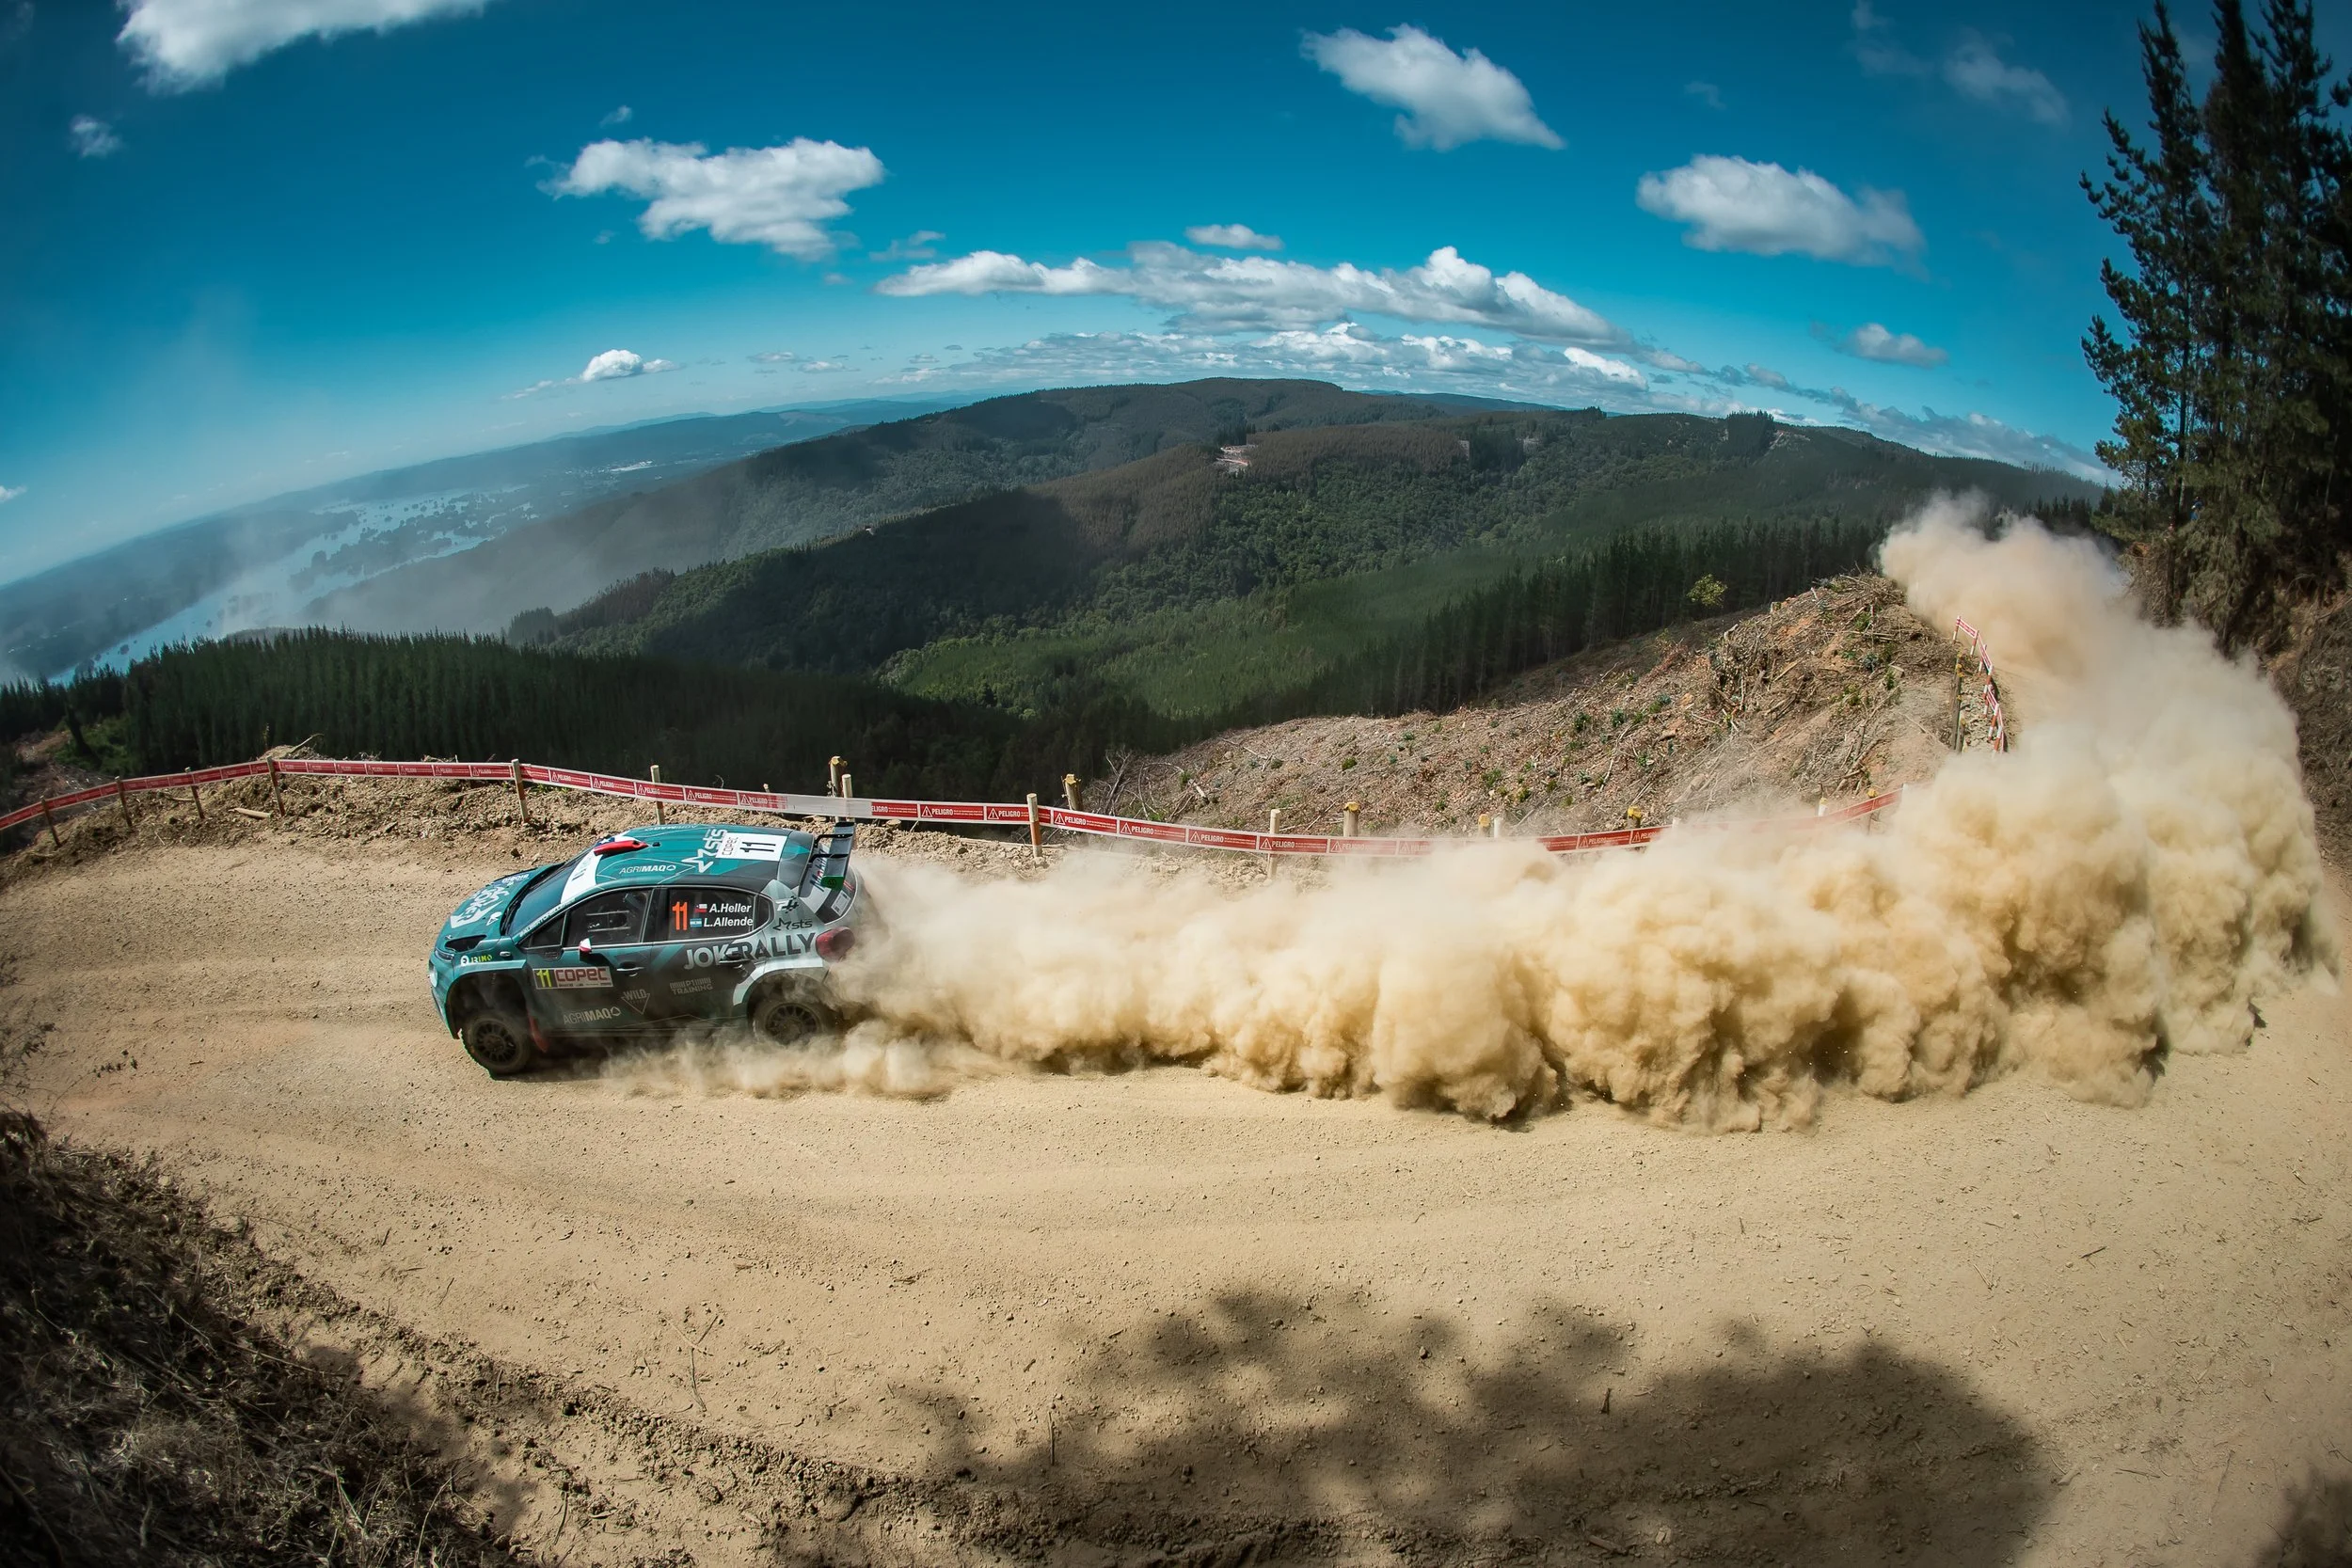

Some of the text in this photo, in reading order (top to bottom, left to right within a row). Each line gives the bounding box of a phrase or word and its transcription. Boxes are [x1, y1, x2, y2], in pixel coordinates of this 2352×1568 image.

[871, 805, 889, 814] ELIGRO
[1064, 816, 1087, 826] PELIGRO
[1131, 825, 1154, 834] PELIGRO
[1200, 833, 1224, 843] PELIGRO
[739, 841, 776, 853] 11
[1271, 840, 1295, 848] PELIGRO
[619, 864, 666, 875] AGRIMAQ
[708, 903, 752, 913] A.Heller
[672, 901, 688, 931] 11
[703, 917, 754, 927] L.Allende
[790, 918, 813, 930] sts
[536, 969, 552, 988] 11
[672, 983, 713, 995] TRAINING
[623, 989, 647, 1001] WILD
[564, 1007, 612, 1024] AGRIMAQ
